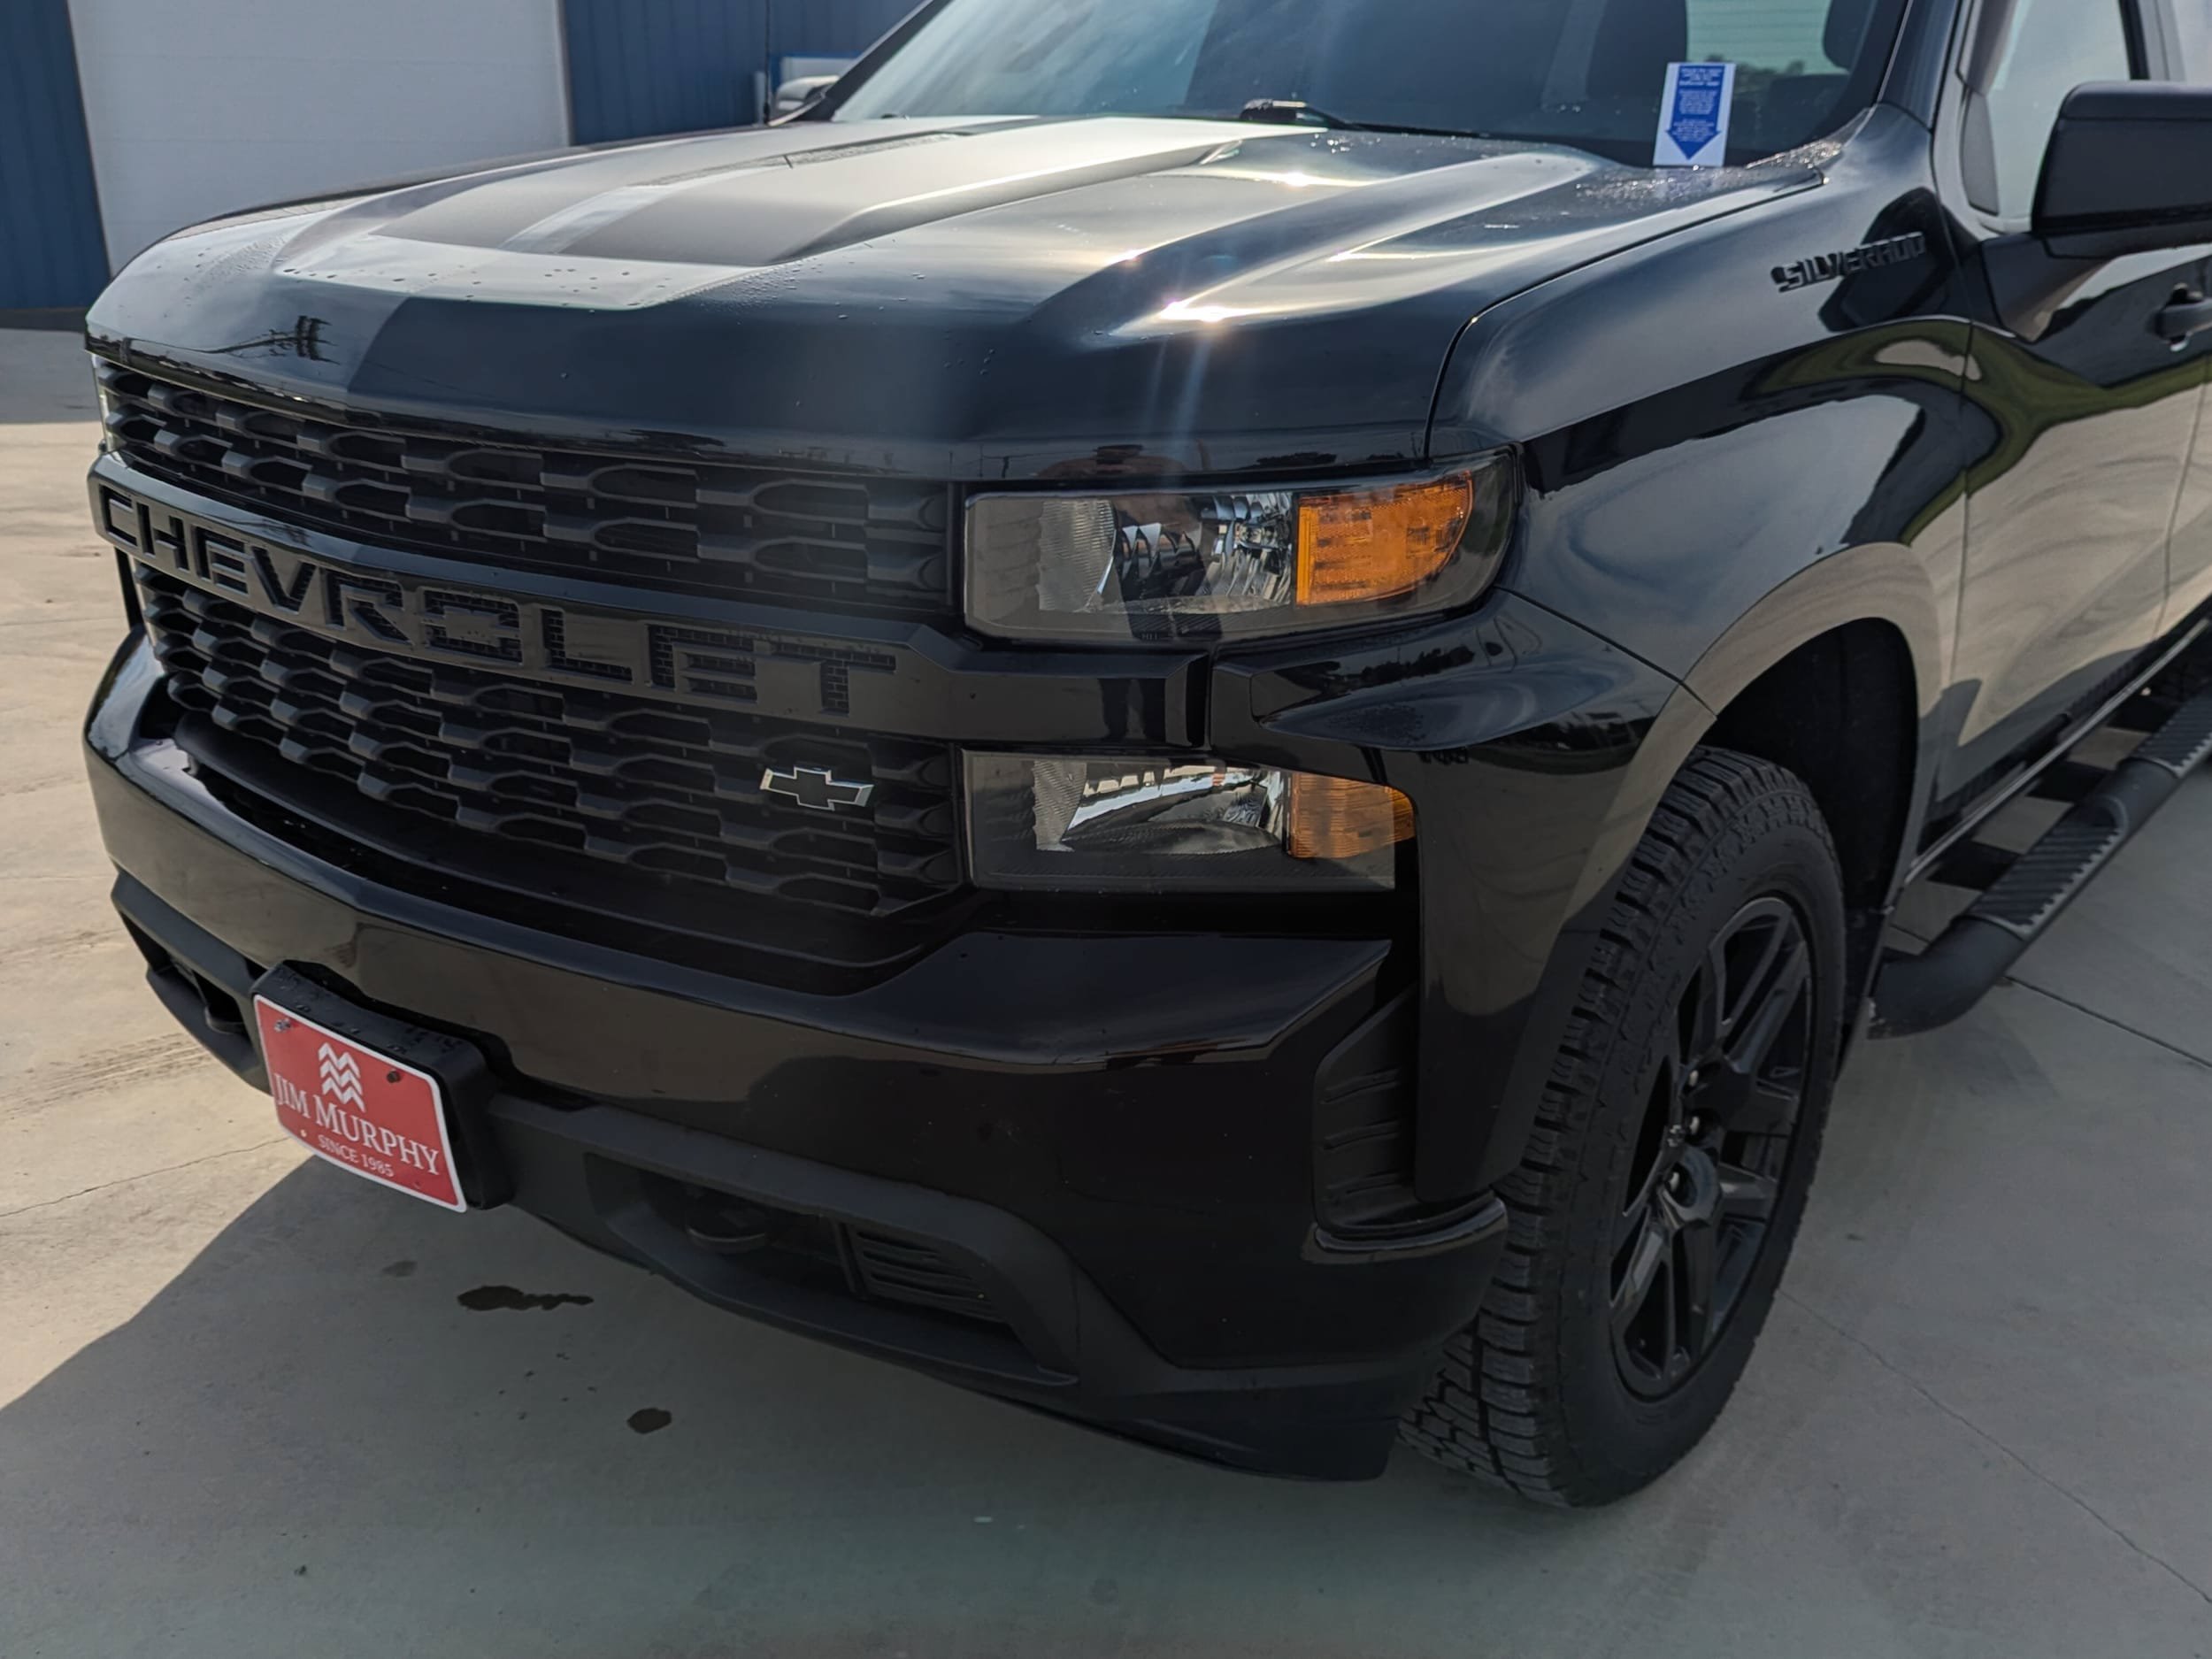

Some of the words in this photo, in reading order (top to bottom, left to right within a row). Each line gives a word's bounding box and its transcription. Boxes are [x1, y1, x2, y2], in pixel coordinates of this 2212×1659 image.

[1770, 232, 1926, 293] SILVERADO
[100, 483, 897, 714] CHEVROLET
[273, 1072, 311, 1119] JIM
[313, 1094, 440, 1176] MURPHY
[318, 1133, 359, 1164] SINCE
[362, 1154, 395, 1178] 1985
